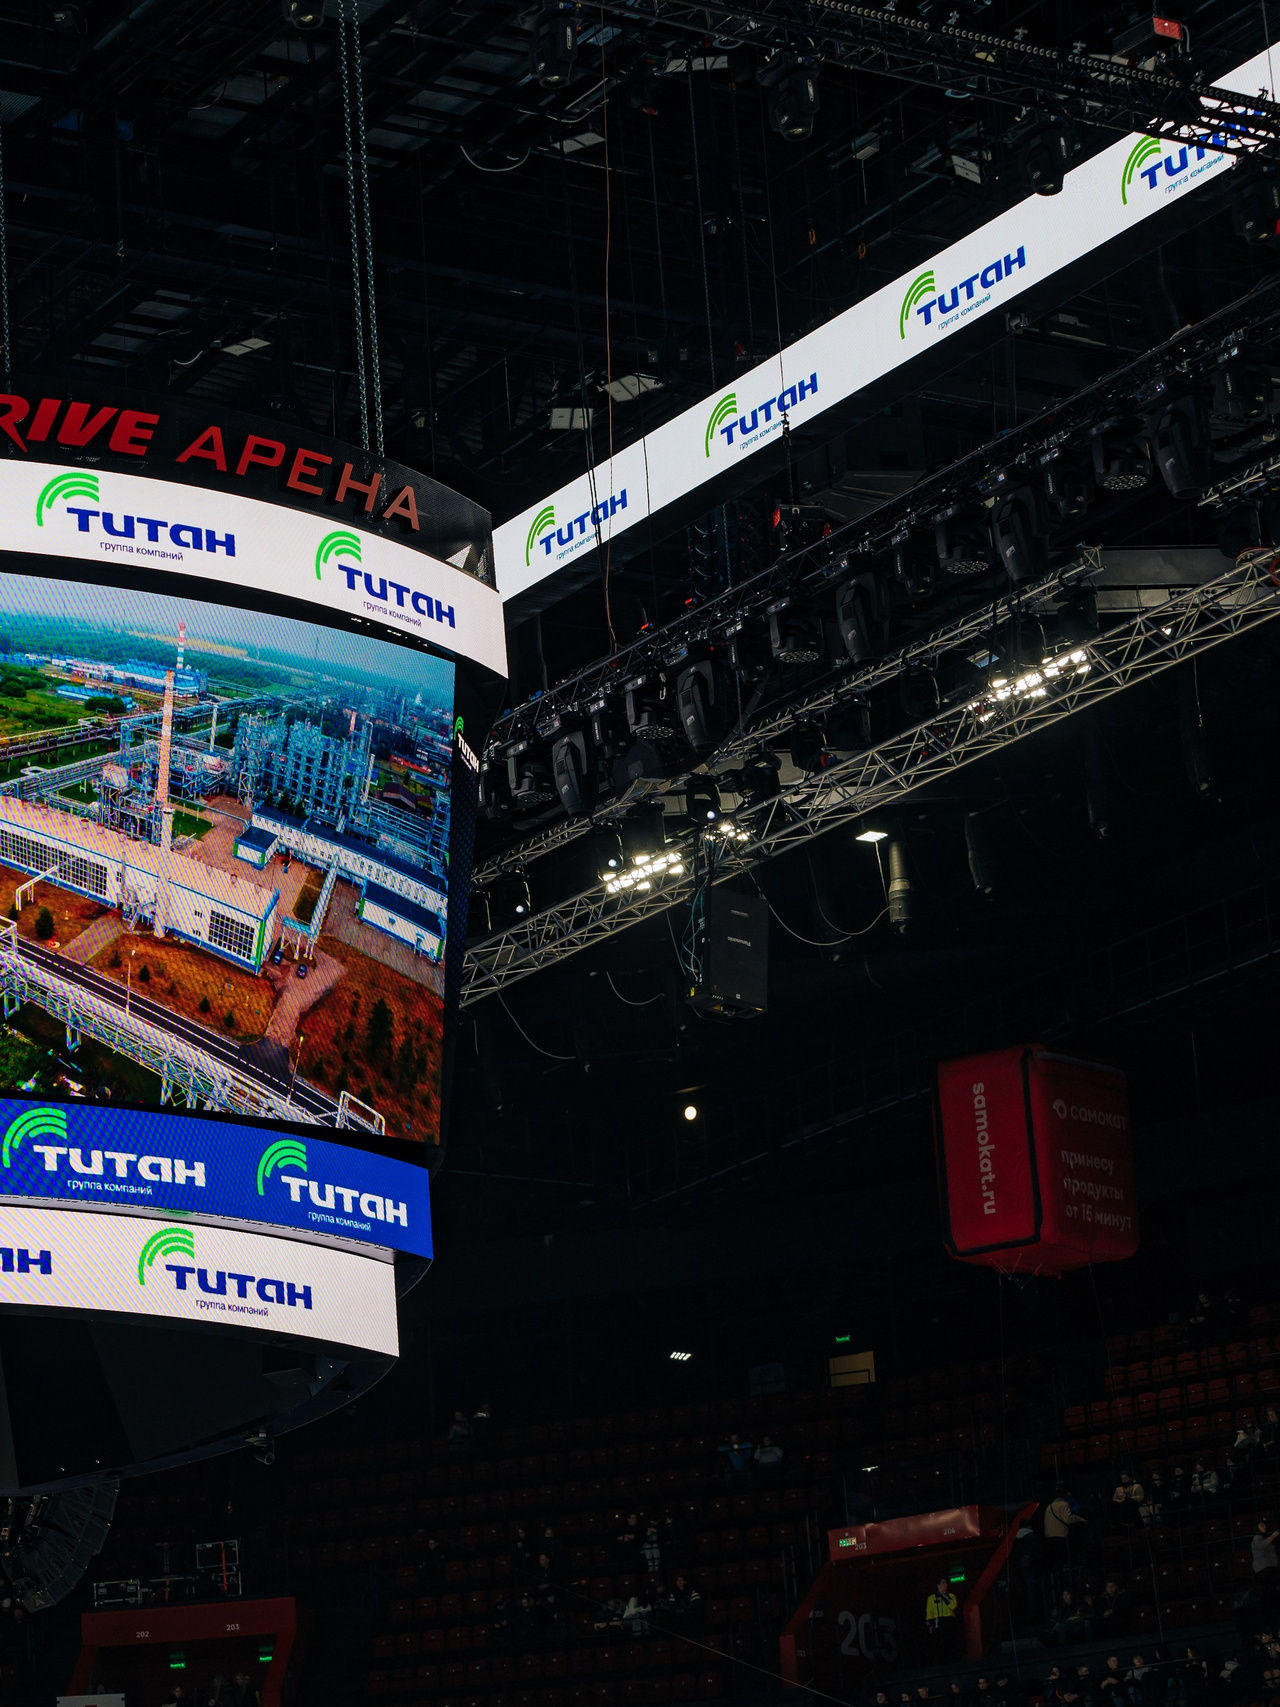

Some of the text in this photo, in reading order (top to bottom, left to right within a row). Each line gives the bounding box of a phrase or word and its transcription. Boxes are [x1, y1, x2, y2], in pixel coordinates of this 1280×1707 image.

[1165, 153, 1225, 194] группа компаний
[938, 293, 991, 330] группа компаний
[740, 421, 783, 450] группа компани
[175, 425, 420, 531] АРЕНА
[100, 541, 183, 561] группа компаний
[556, 531, 598, 560] группа компани
[363, 600, 422, 628] группа компаний
[1071, 1105, 1127, 1130] самокат
[973, 1082, 996, 1215] samokat.ru
[1061, 1150, 1114, 1176] принесу
[67, 1179, 153, 1195] группа компаний
[1064, 1177, 1123, 1201] продукты
[308, 1211, 371, 1232] группа компаний
[1066, 1203, 1132, 1232] от 15 минут
[196, 1299, 269, 1316] группа компаний
[943, 1527, 956, 1536] 204
[855, 1543, 867, 1551] 203
[136, 1631, 150, 1639] 202
[226, 1623, 240, 1631] 203
[838, 1610, 898, 1662] 203
